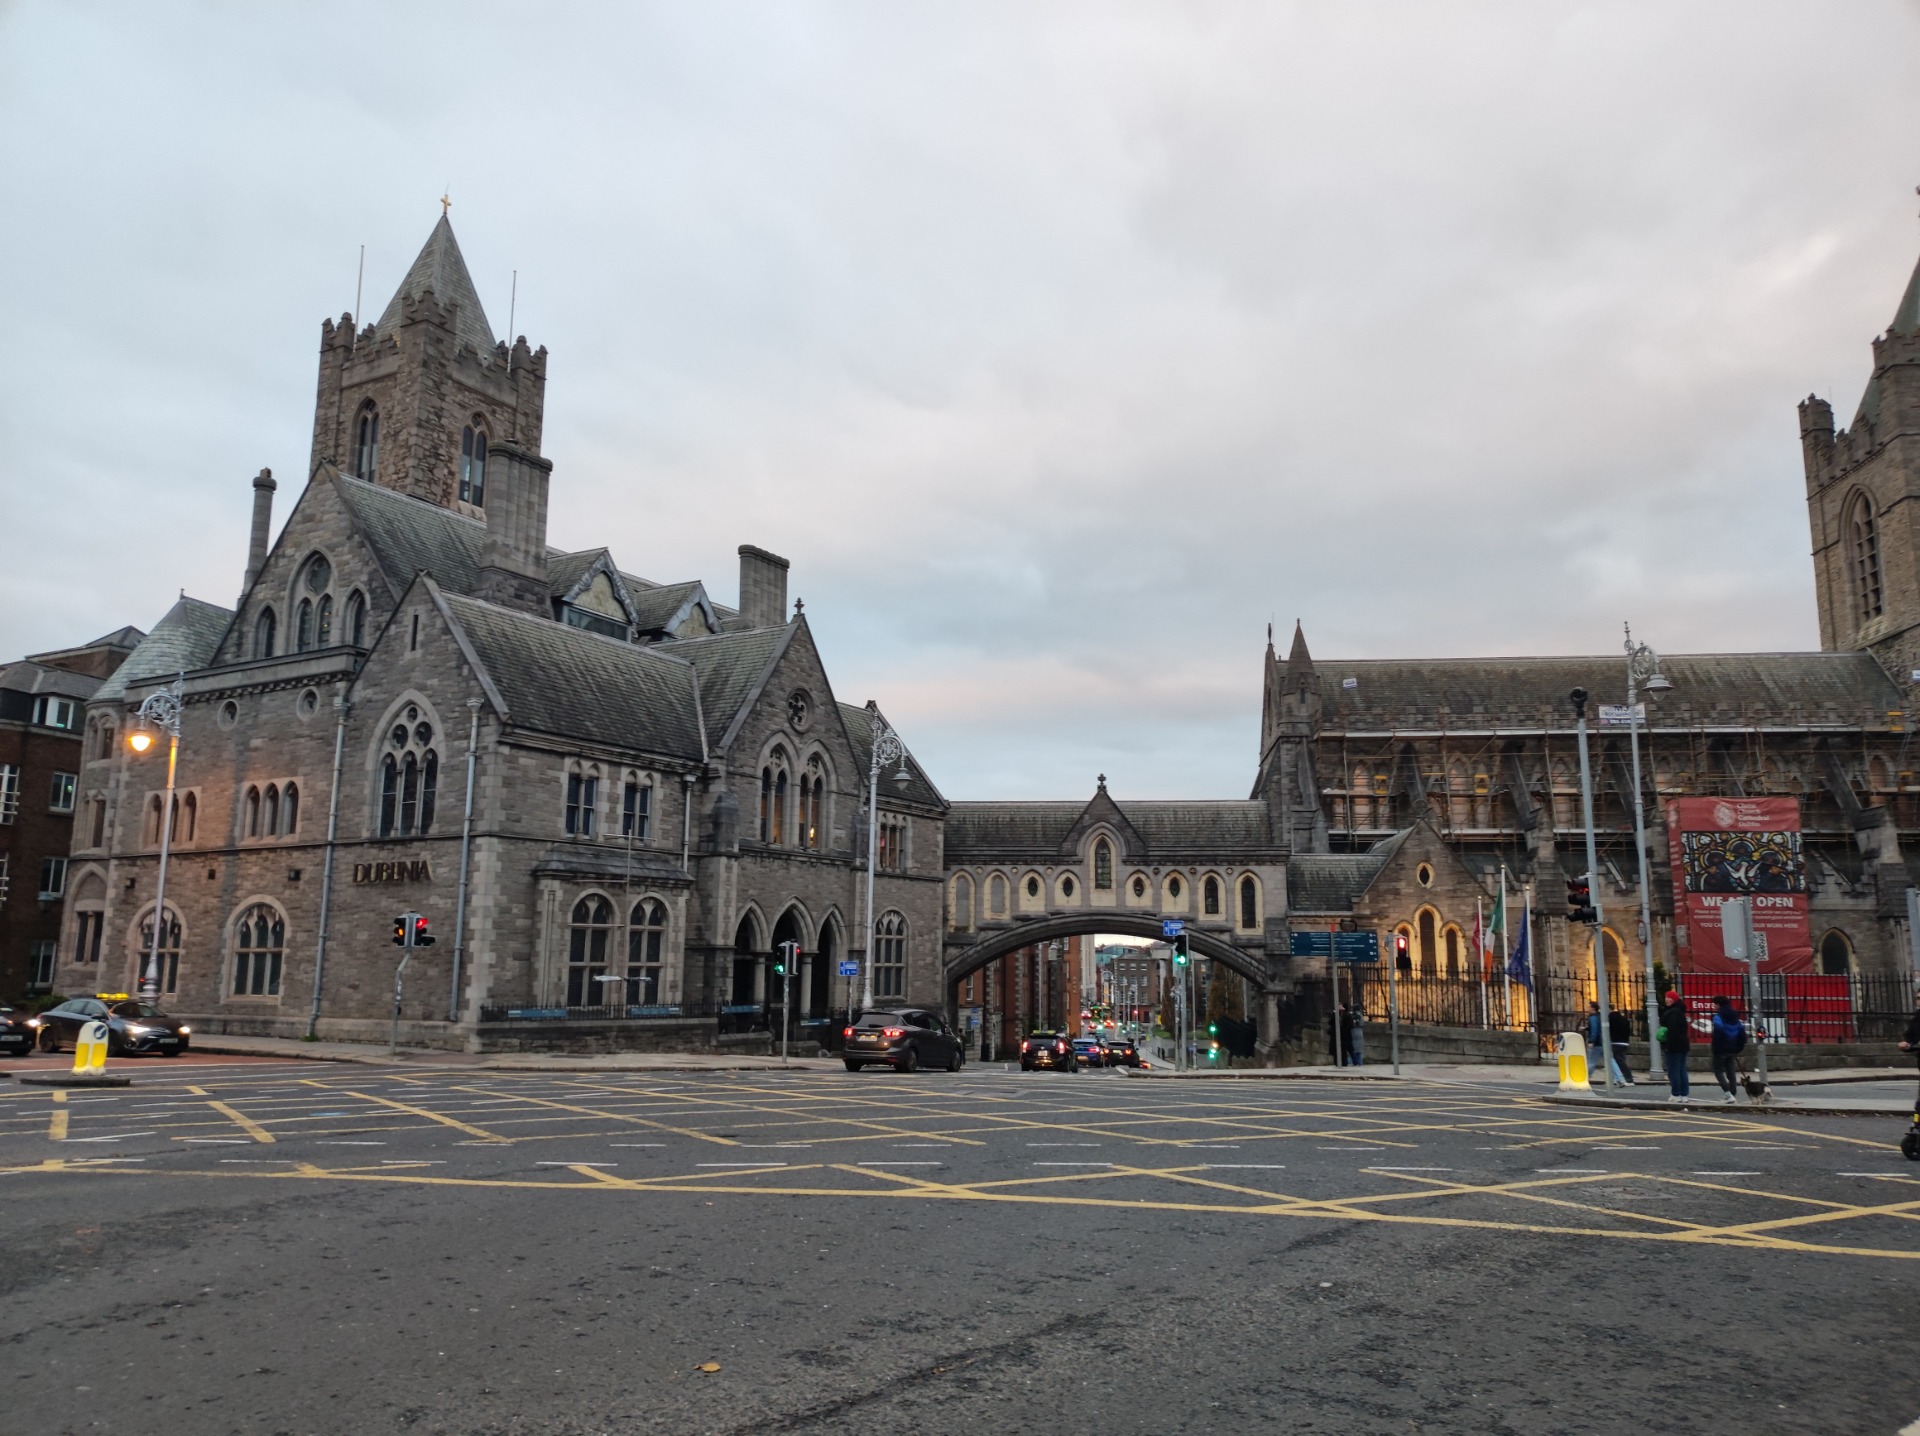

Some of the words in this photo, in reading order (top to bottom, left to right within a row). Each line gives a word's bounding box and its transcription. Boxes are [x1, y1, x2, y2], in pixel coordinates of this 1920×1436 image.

[353, 860, 432, 883] DUBLINIA
[1701, 896, 1723, 907] WE
[1756, 896, 1794, 907] OPEN
